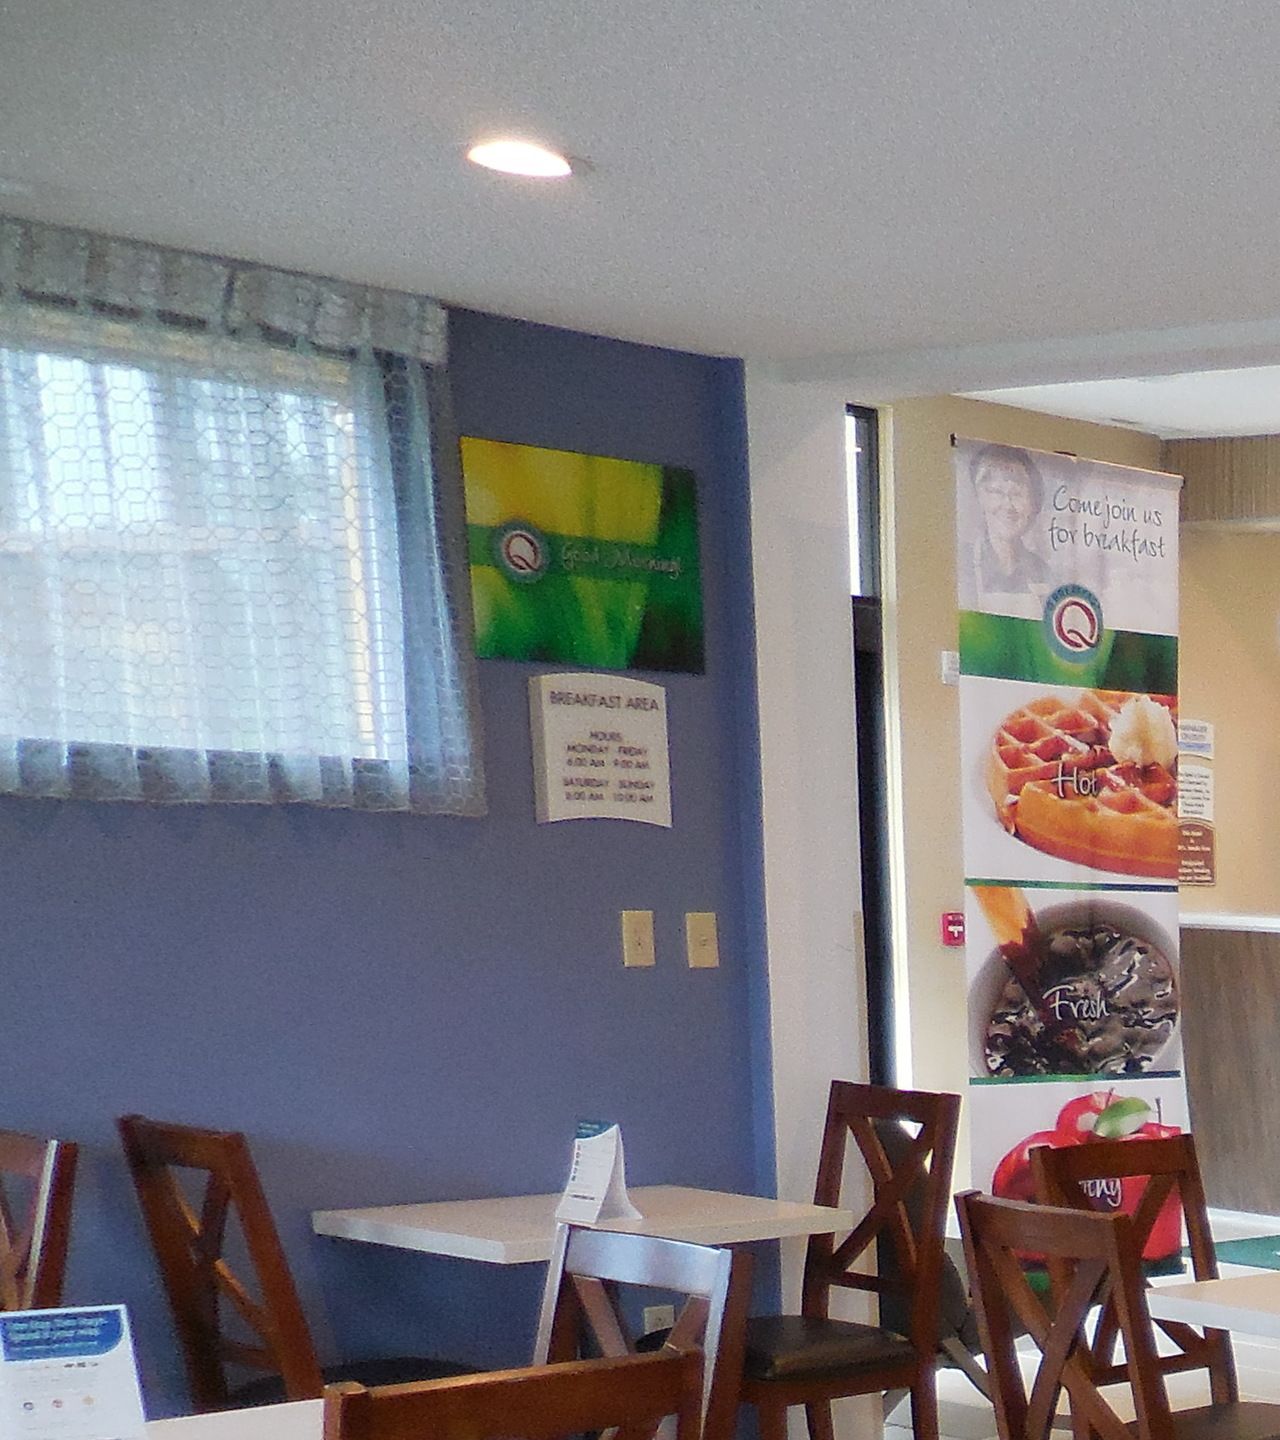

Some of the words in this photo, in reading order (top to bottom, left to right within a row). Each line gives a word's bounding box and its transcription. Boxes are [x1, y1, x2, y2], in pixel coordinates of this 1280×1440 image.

[1053, 485, 1101, 516] Come
[1103, 494, 1137, 527] join
[1143, 507, 1163, 526] us
[1048, 517, 1078, 551] for
[1083, 523, 1165, 562] breakfast
[1054, 600, 1100, 648] Q
[550, 691, 621, 709] BREAKFAST
[627, 697, 659, 711] AREA
[1050, 761, 1098, 798] Hot
[1042, 985, 1110, 1020] Fresh
